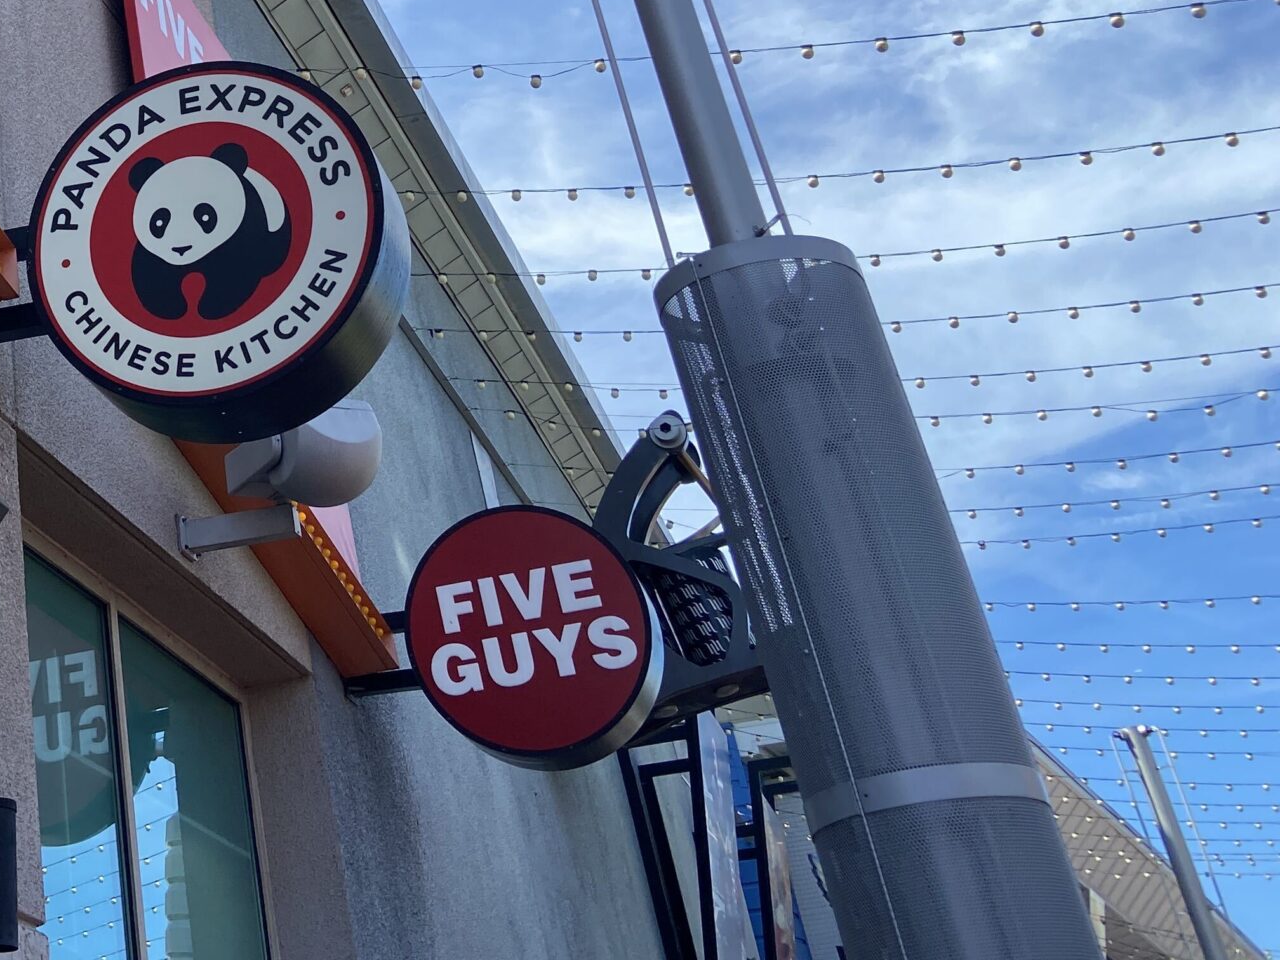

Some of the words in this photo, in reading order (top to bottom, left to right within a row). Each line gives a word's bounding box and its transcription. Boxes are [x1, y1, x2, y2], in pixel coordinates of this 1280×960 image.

[50, 104, 166, 233] PANDA
[178, 83, 351, 186] EXPRESS
[64, 290, 197, 378] CHINESE
[214, 248, 348, 373] KITCHEN
[435, 558, 603, 635] FIVE
[430, 615, 638, 697] GUYS
